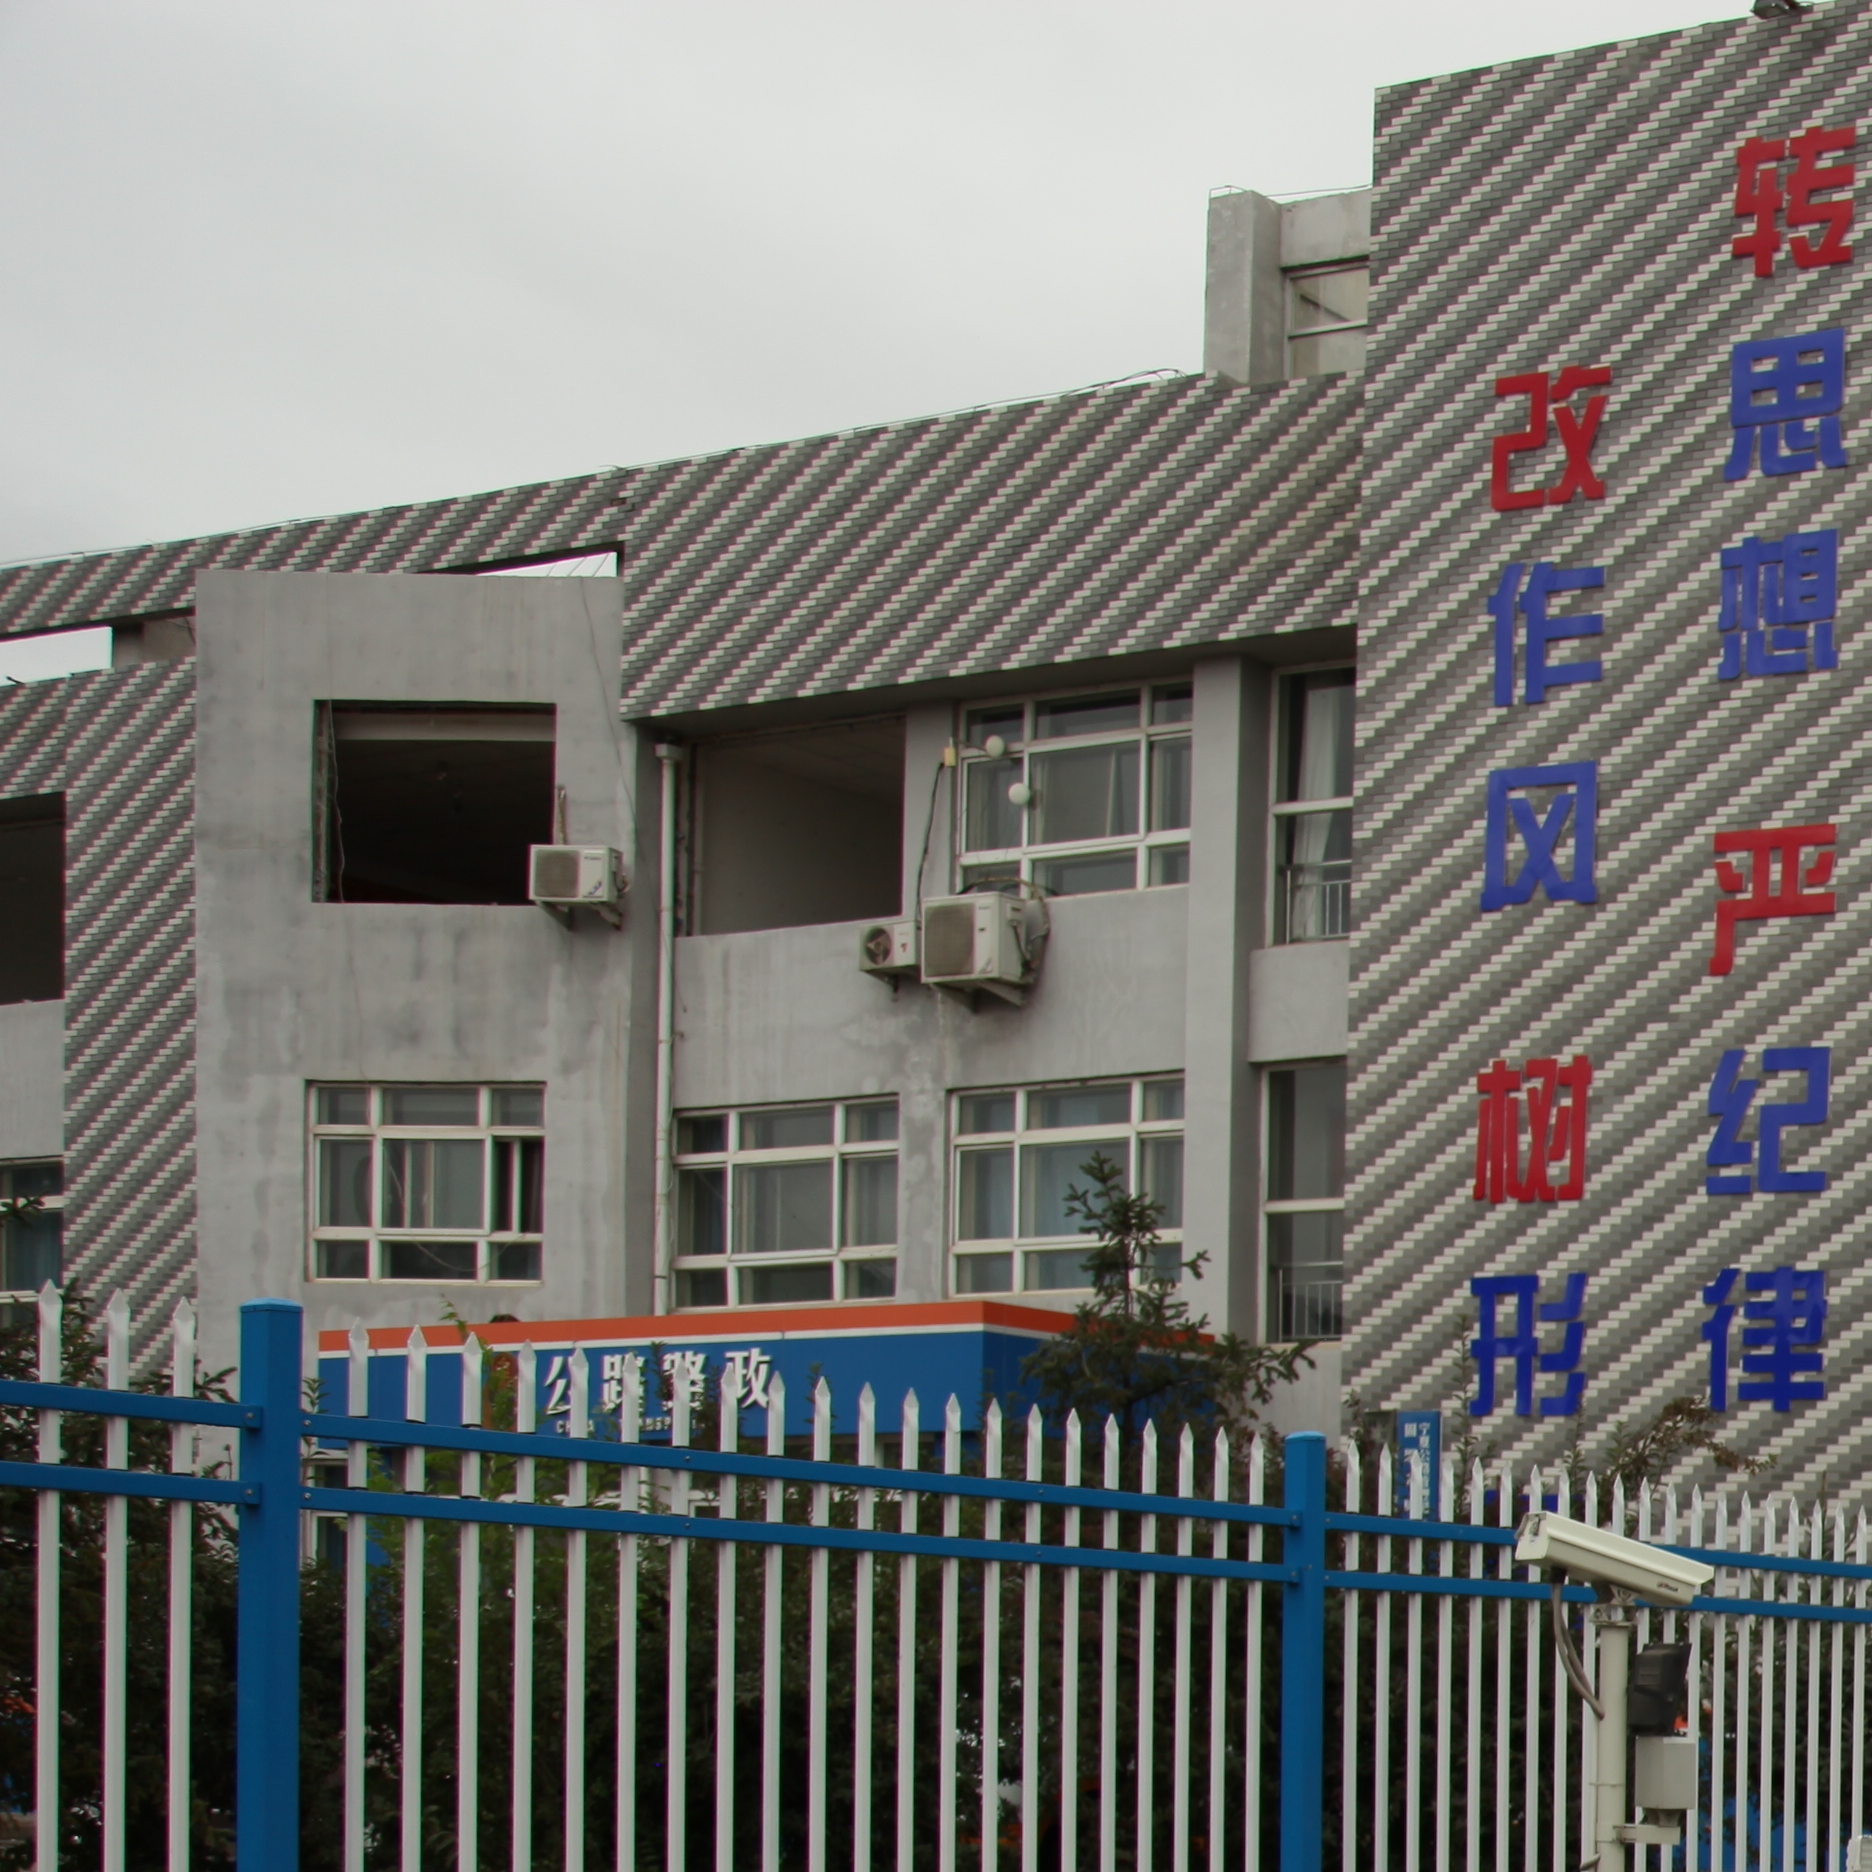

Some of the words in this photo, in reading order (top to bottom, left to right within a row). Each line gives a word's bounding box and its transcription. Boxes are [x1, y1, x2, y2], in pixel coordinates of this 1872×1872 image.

[1481, 366, 1610, 909] 改作风
[1720, 126, 1855, 678] 转思想
[1470, 1055, 1592, 1515] 树形
[1702, 823, 1836, 1411] 严纪律
